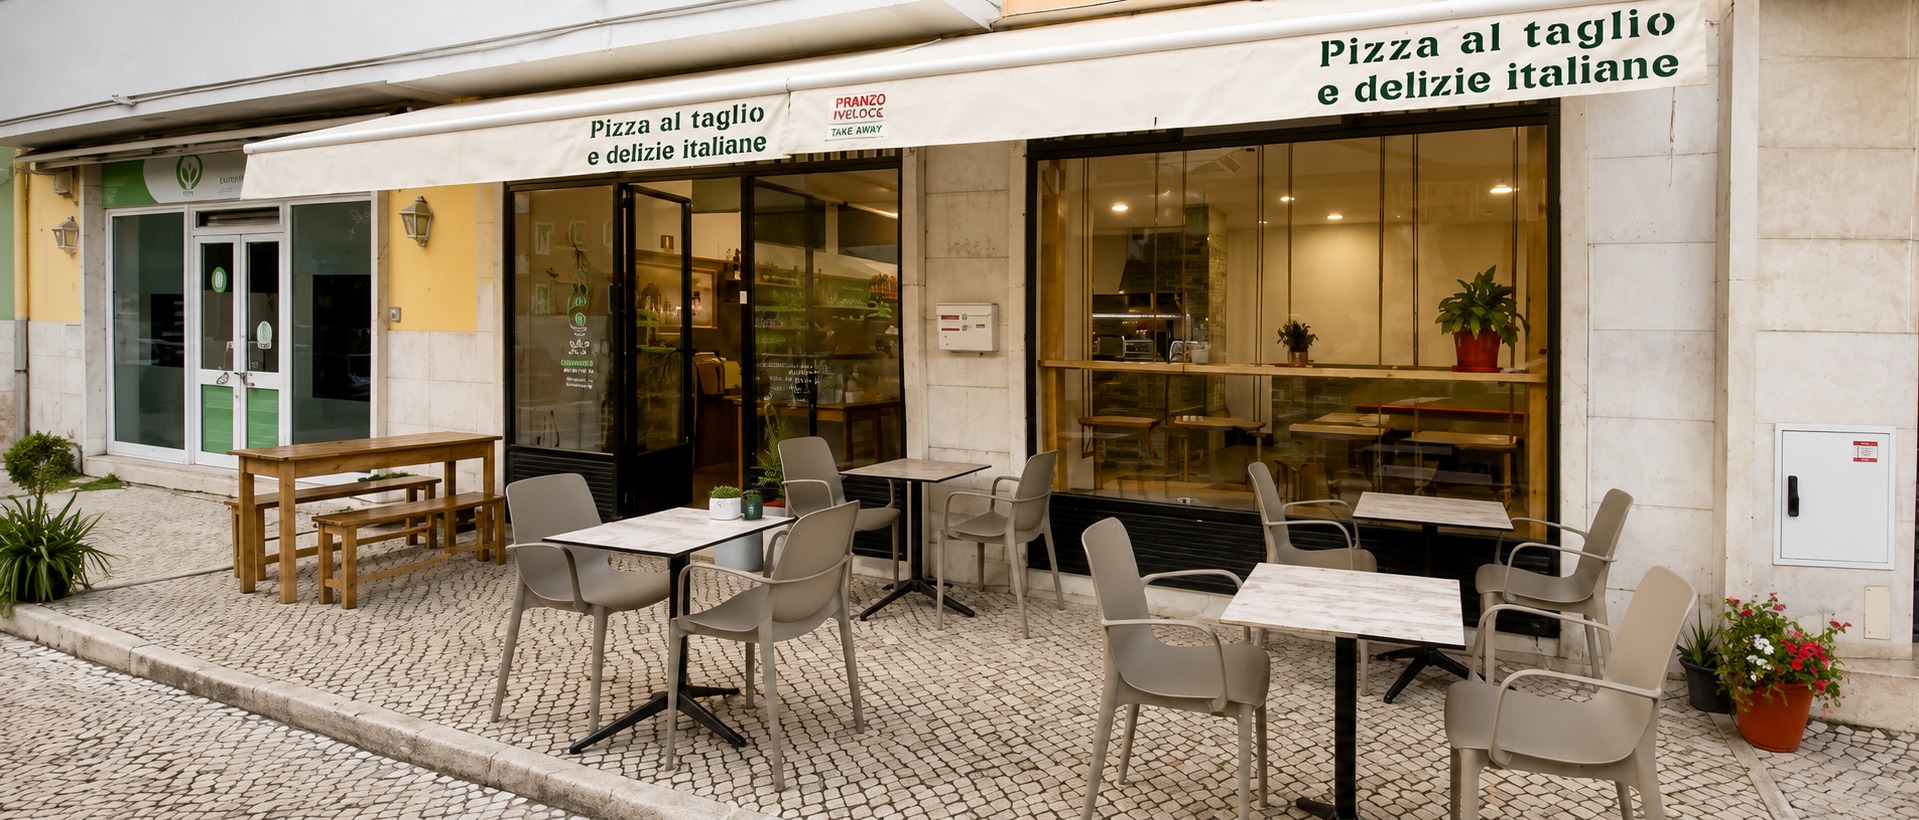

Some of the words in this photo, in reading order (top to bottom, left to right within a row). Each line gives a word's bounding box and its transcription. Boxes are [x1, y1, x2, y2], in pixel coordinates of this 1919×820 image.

[1320, 37, 1440, 68] Pizza
[1460, 22, 1501, 55] al
[1523, 8, 1676, 50] taglio
[1317, 84, 1339, 106] e
[1354, 66, 1491, 103] delizie
[1507, 54, 1679, 91] italiane
[835, 93, 887, 109] PRANZO
[590, 118, 650, 139] Pizza
[659, 111, 681, 132] al
[690, 103, 765, 131] taglio
[830, 126, 854, 137] TAKE
[855, 124, 883, 135] AWAY
[587, 151, 600, 166] e
[606, 142, 675, 165] delizie
[682, 135, 767, 159] italiane
